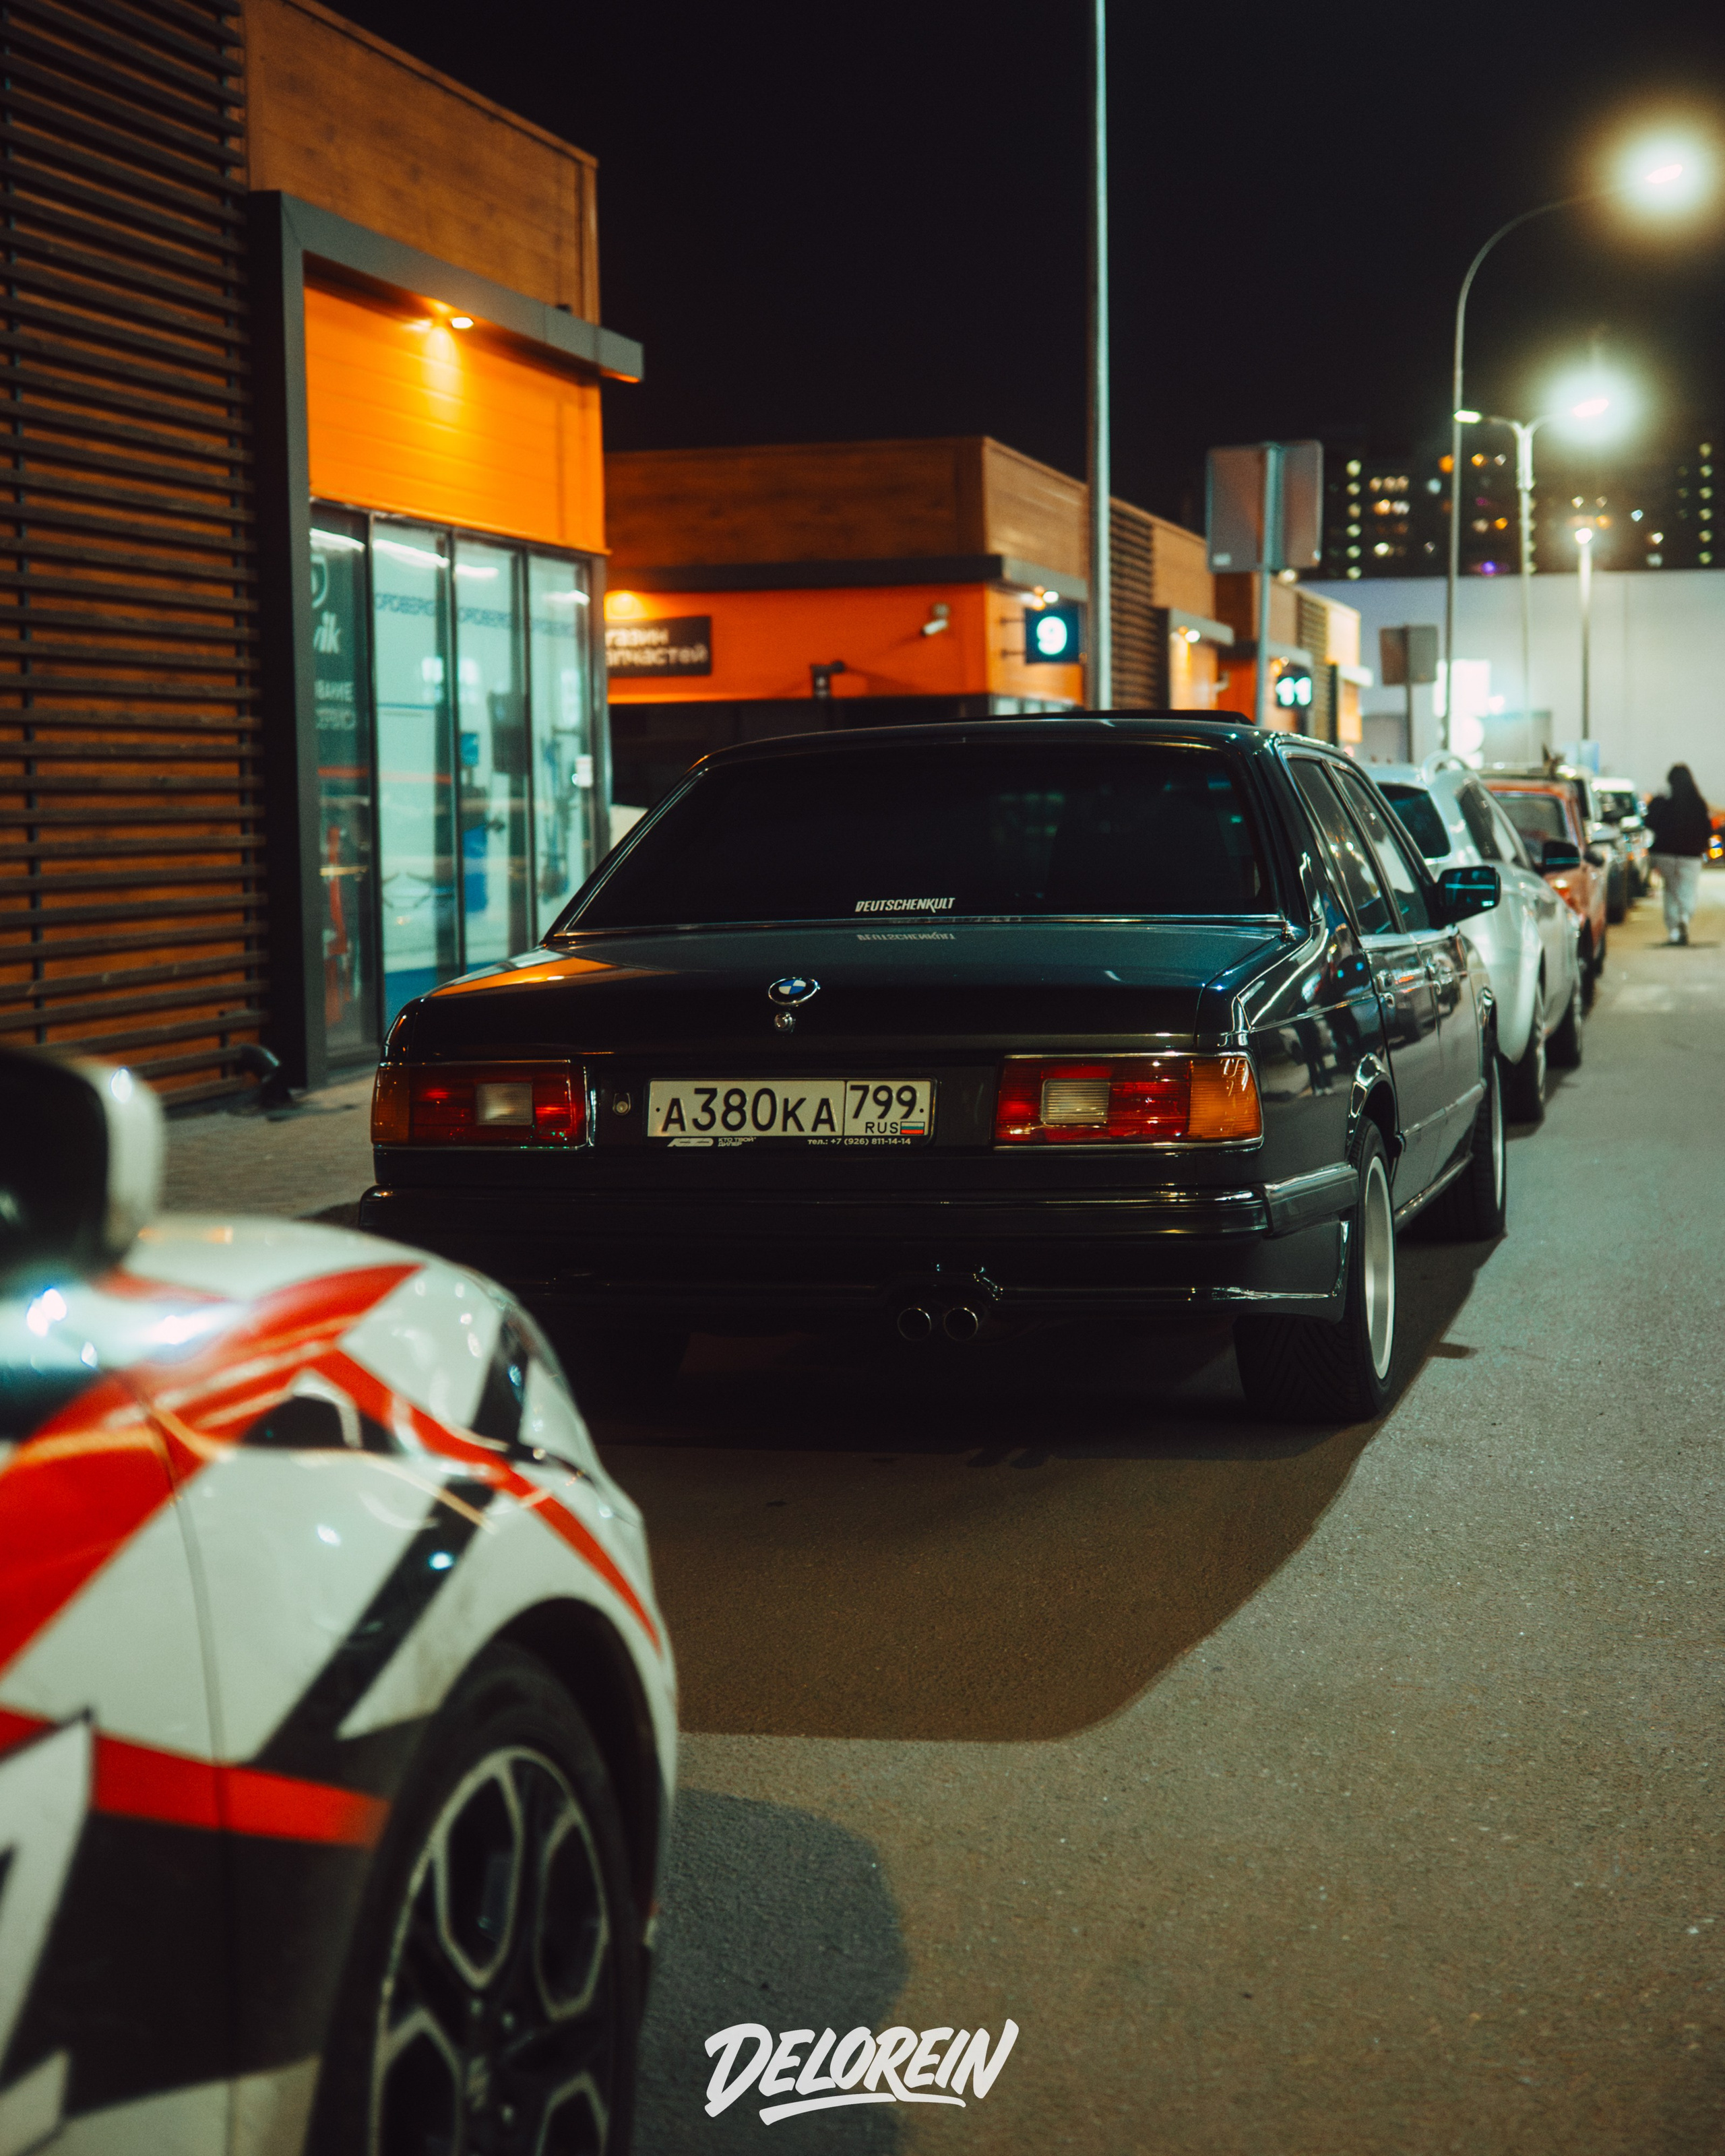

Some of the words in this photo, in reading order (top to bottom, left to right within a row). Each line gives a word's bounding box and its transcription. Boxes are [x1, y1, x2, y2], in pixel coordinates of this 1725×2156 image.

[1036, 616, 1067, 655] 9
[1276, 676, 1312, 706] 11
[854, 897, 955, 914] DEUTSCHENKULT
[850, 1085, 917, 1119] 799
[865, 1122, 899, 1134] RUS
